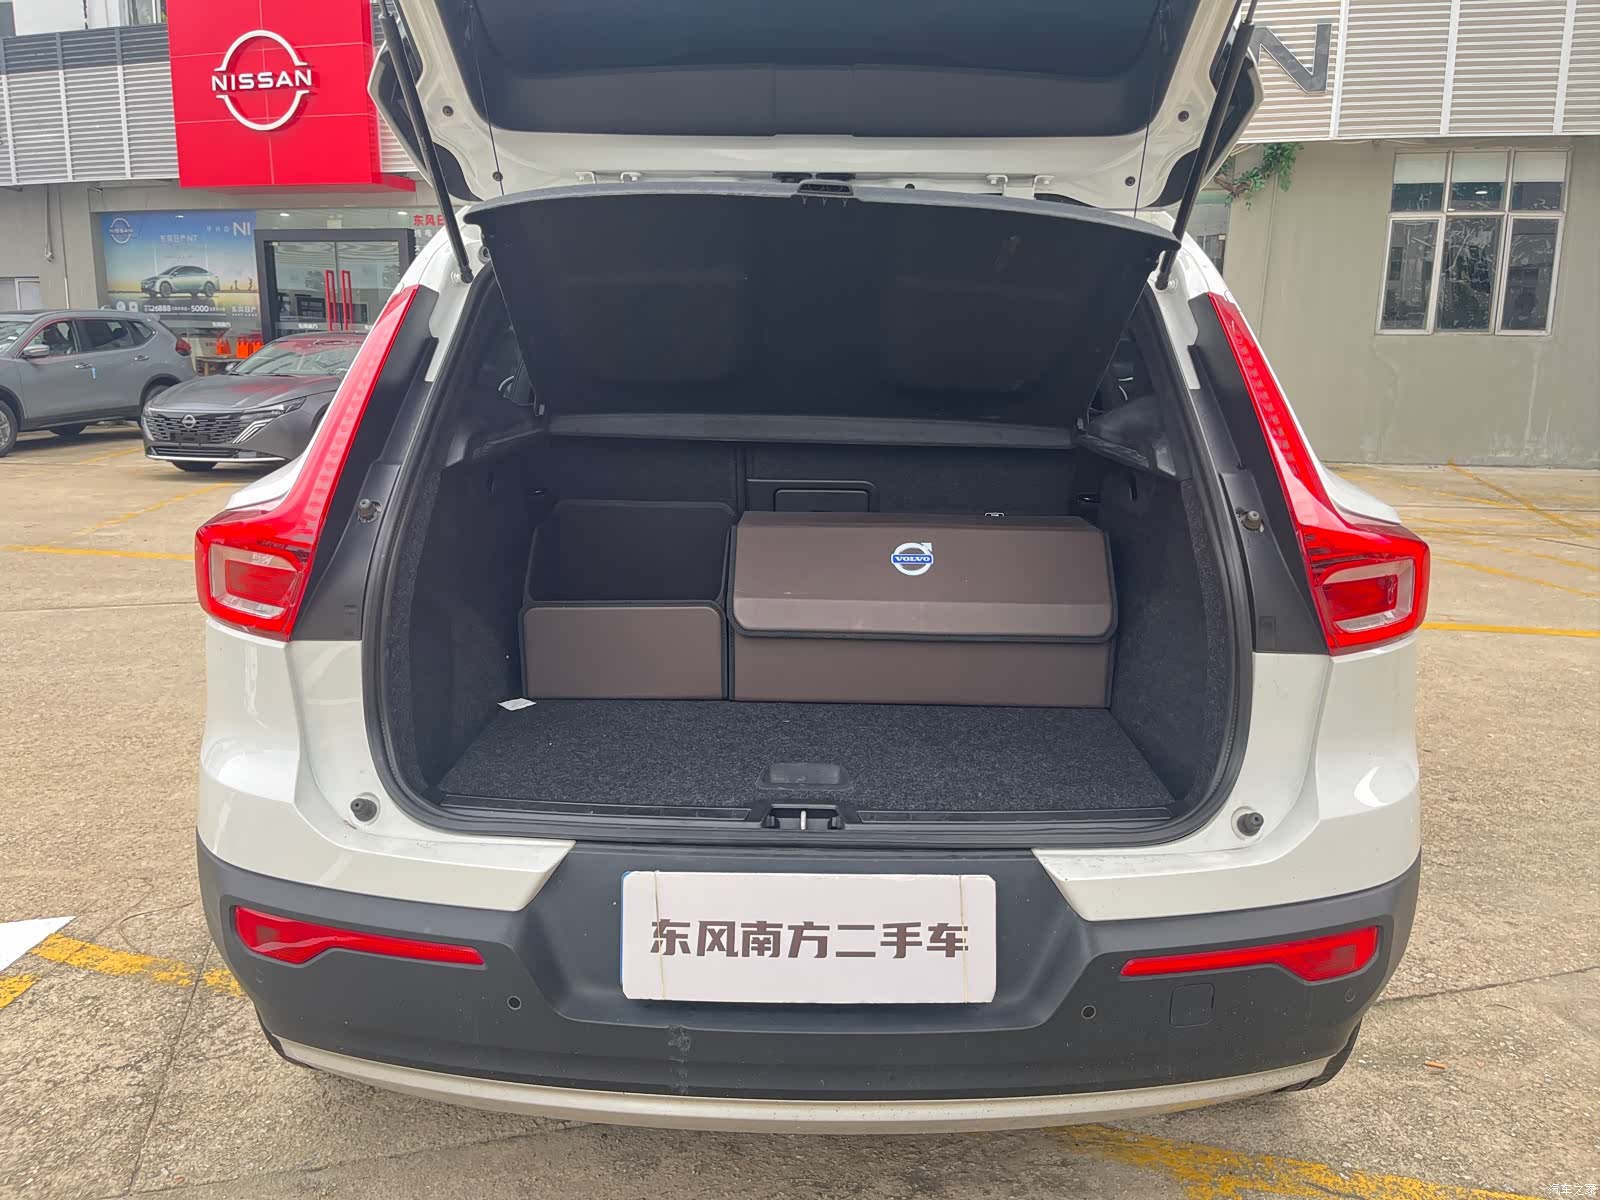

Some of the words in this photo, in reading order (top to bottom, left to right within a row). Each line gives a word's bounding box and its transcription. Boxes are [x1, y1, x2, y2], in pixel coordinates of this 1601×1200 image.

[211, 69, 312, 91] NISSAN
[650, 918, 969, 959] 东风南方二手车
